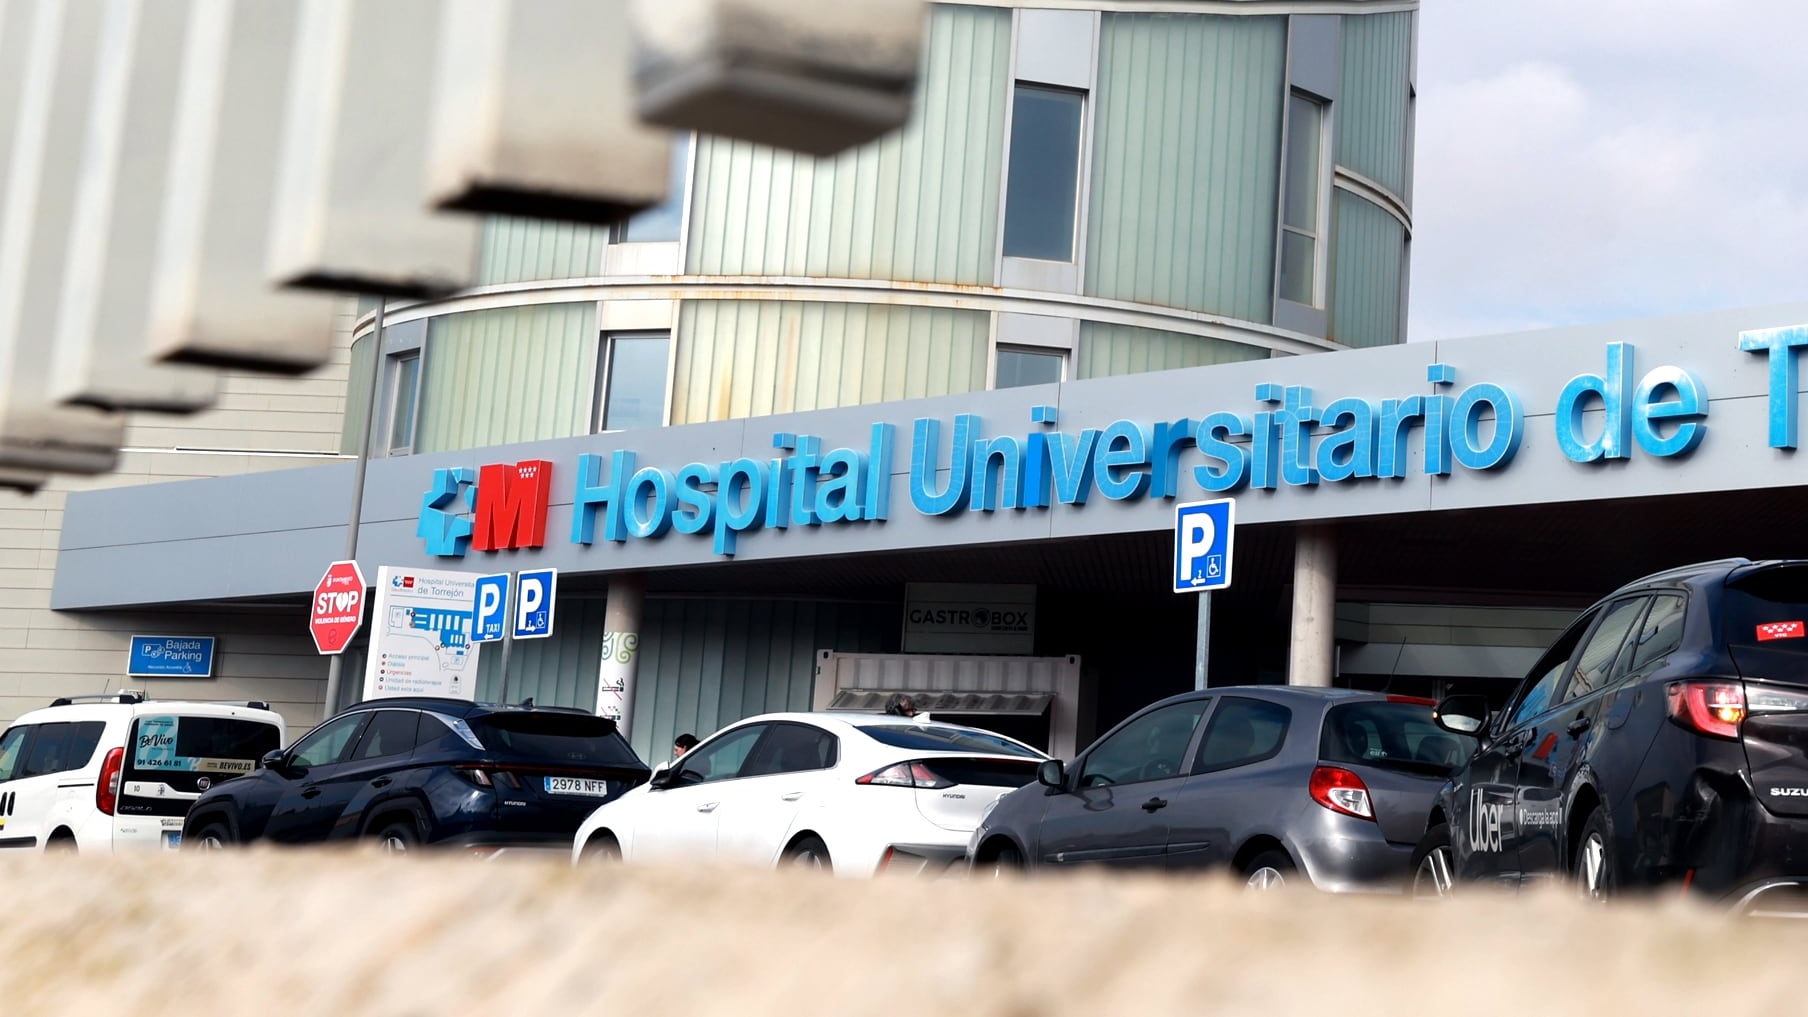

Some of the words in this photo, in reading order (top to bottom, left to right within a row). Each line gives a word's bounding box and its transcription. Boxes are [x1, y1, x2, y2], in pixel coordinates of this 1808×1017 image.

[570, 420, 896, 555] Hospital
[909, 363, 1525, 516] Universitario
[1556, 341, 1709, 463] de
[1180, 512, 1215, 581] P
[418, 577, 444, 585] Hospital
[445, 578, 475, 587] Universita
[417, 587, 428, 595] de
[431, 586, 464, 598] Torrejón
[316, 590, 359, 615] STOP
[476, 583, 500, 635] P
[517, 578, 543, 631] P
[486, 623, 501, 633] TAXI
[144, 645, 152, 654] P
[165, 639, 201, 651] Bajada
[164, 650, 202, 662] Parking
[219, 761, 251, 771] BEVIVO.ES
[552, 778, 581, 791] 2978
[584, 780, 604, 793] NFF
[1469, 787, 1503, 853] Uber
[1523, 808, 1545, 830] Descarga
